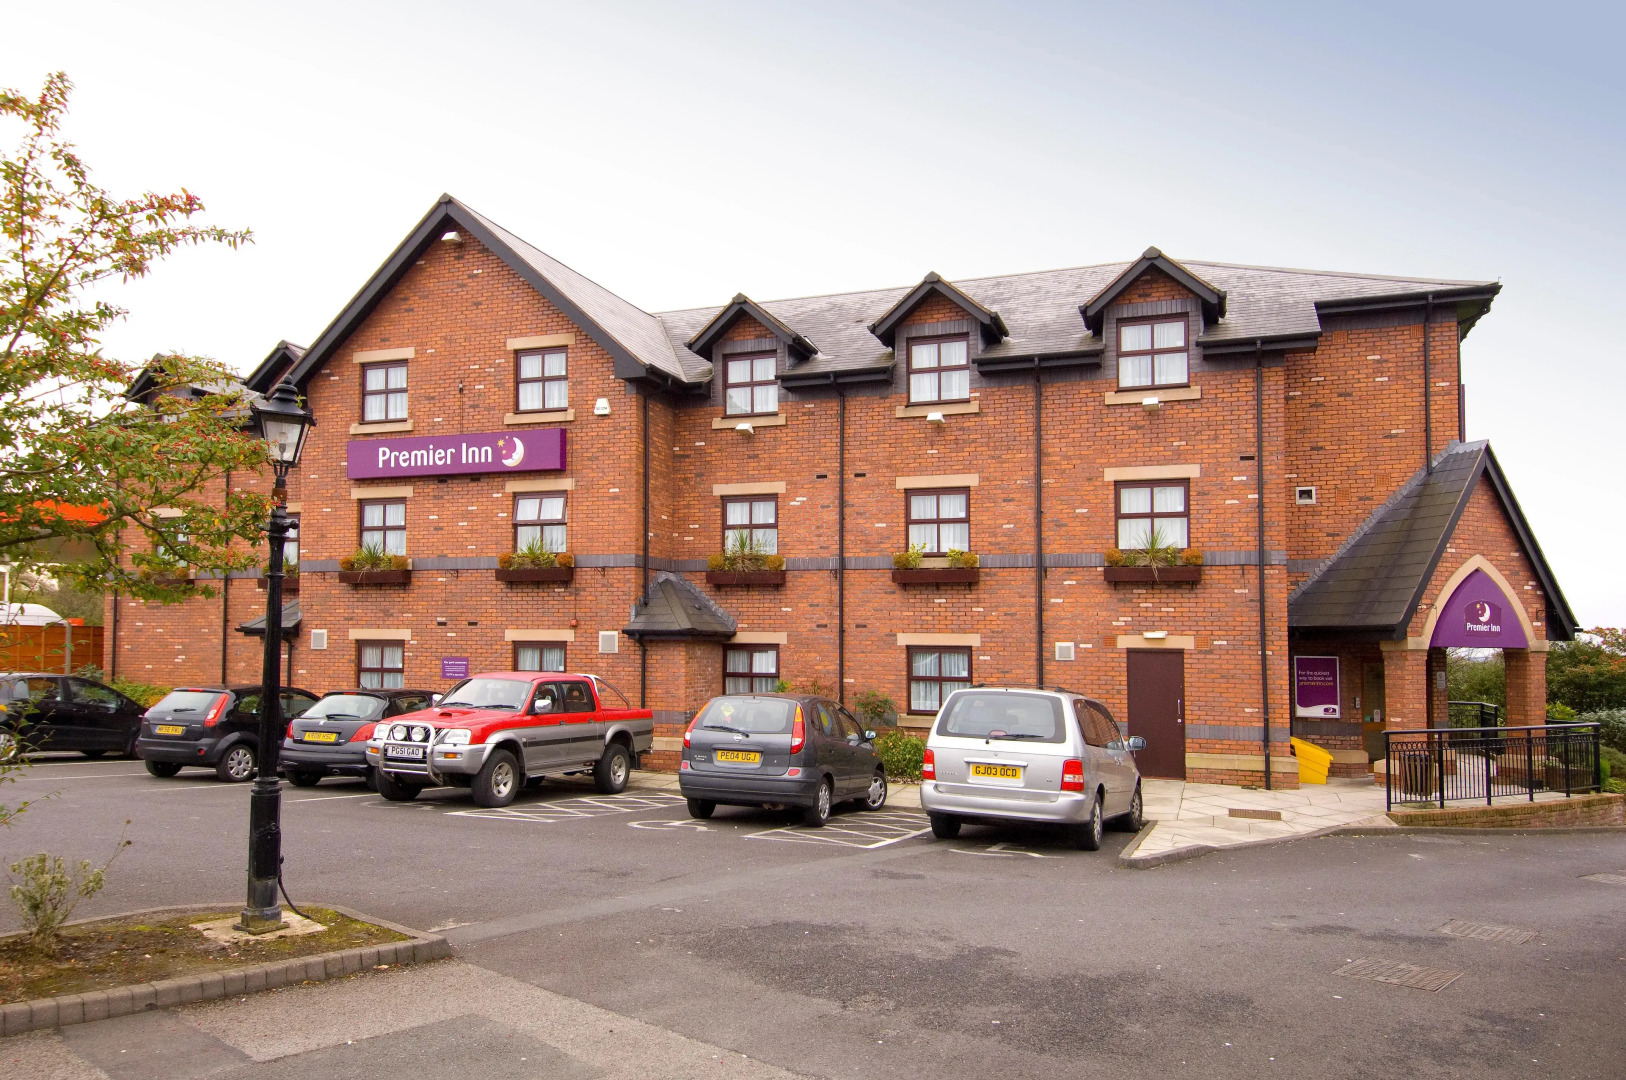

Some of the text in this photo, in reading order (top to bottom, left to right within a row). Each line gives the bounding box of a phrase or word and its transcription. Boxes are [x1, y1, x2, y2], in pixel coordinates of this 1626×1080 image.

[378, 442, 492, 468] Premier Inn
[1466, 622, 1501, 632] Premier Inn
[720, 751, 757, 761] PE04 UGJ
[975, 765, 1017, 777] GJ03 OCD
